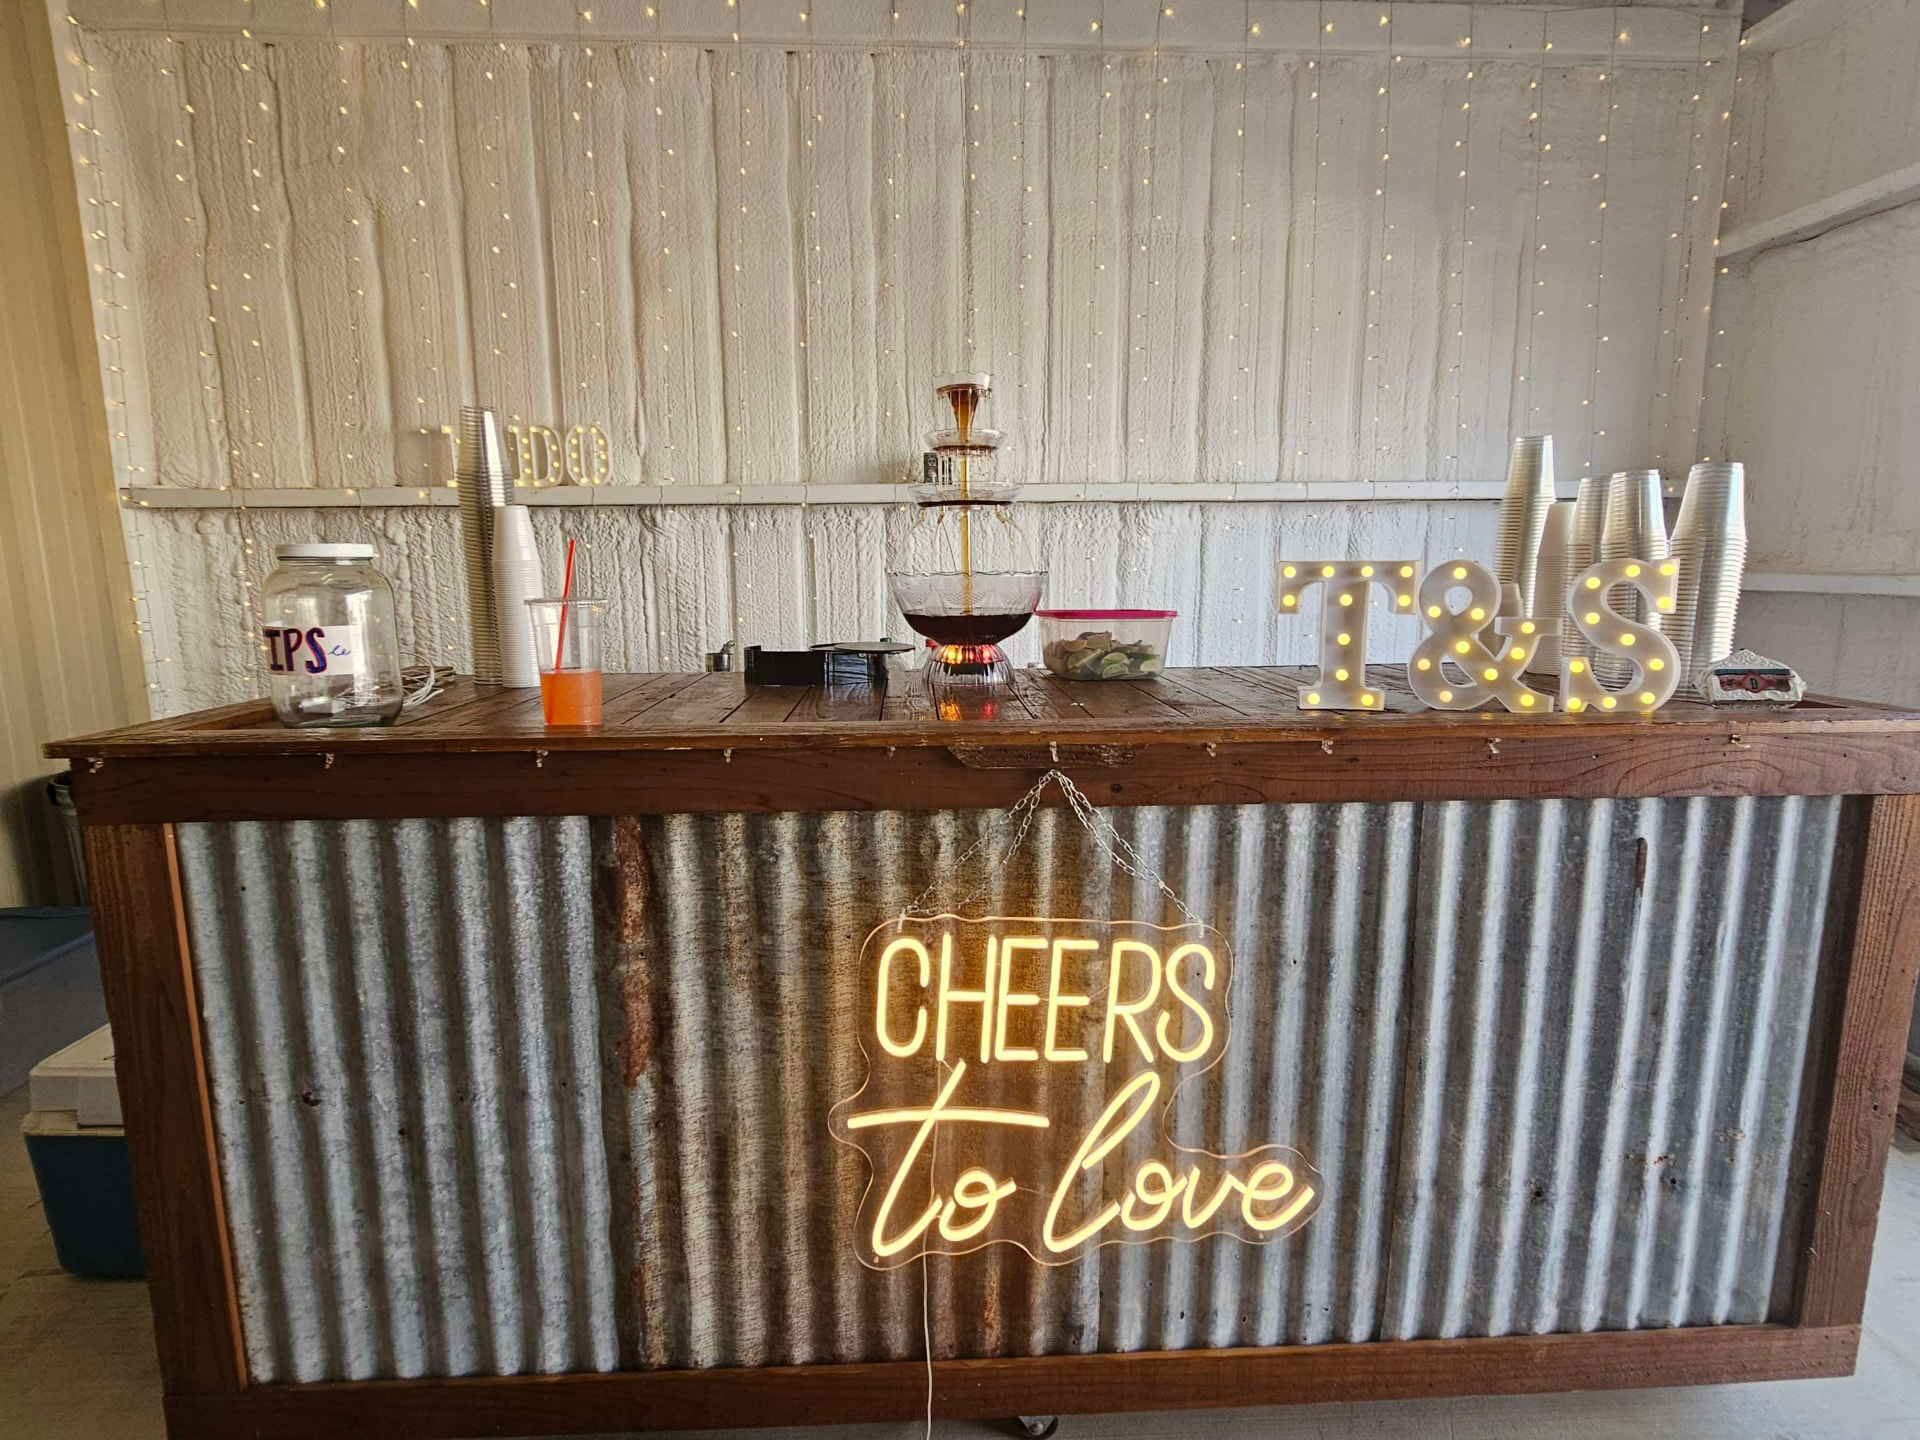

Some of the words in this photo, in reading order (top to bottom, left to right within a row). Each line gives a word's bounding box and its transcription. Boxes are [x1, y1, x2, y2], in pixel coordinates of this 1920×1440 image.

[509, 424, 611, 487] DO
[263, 626, 327, 674] IPS
[1278, 559, 1680, 712] T&S
[876, 931, 1216, 1063] CHEERS
[847, 1060, 1050, 1257] to
[1043, 1071, 1315, 1253] love
